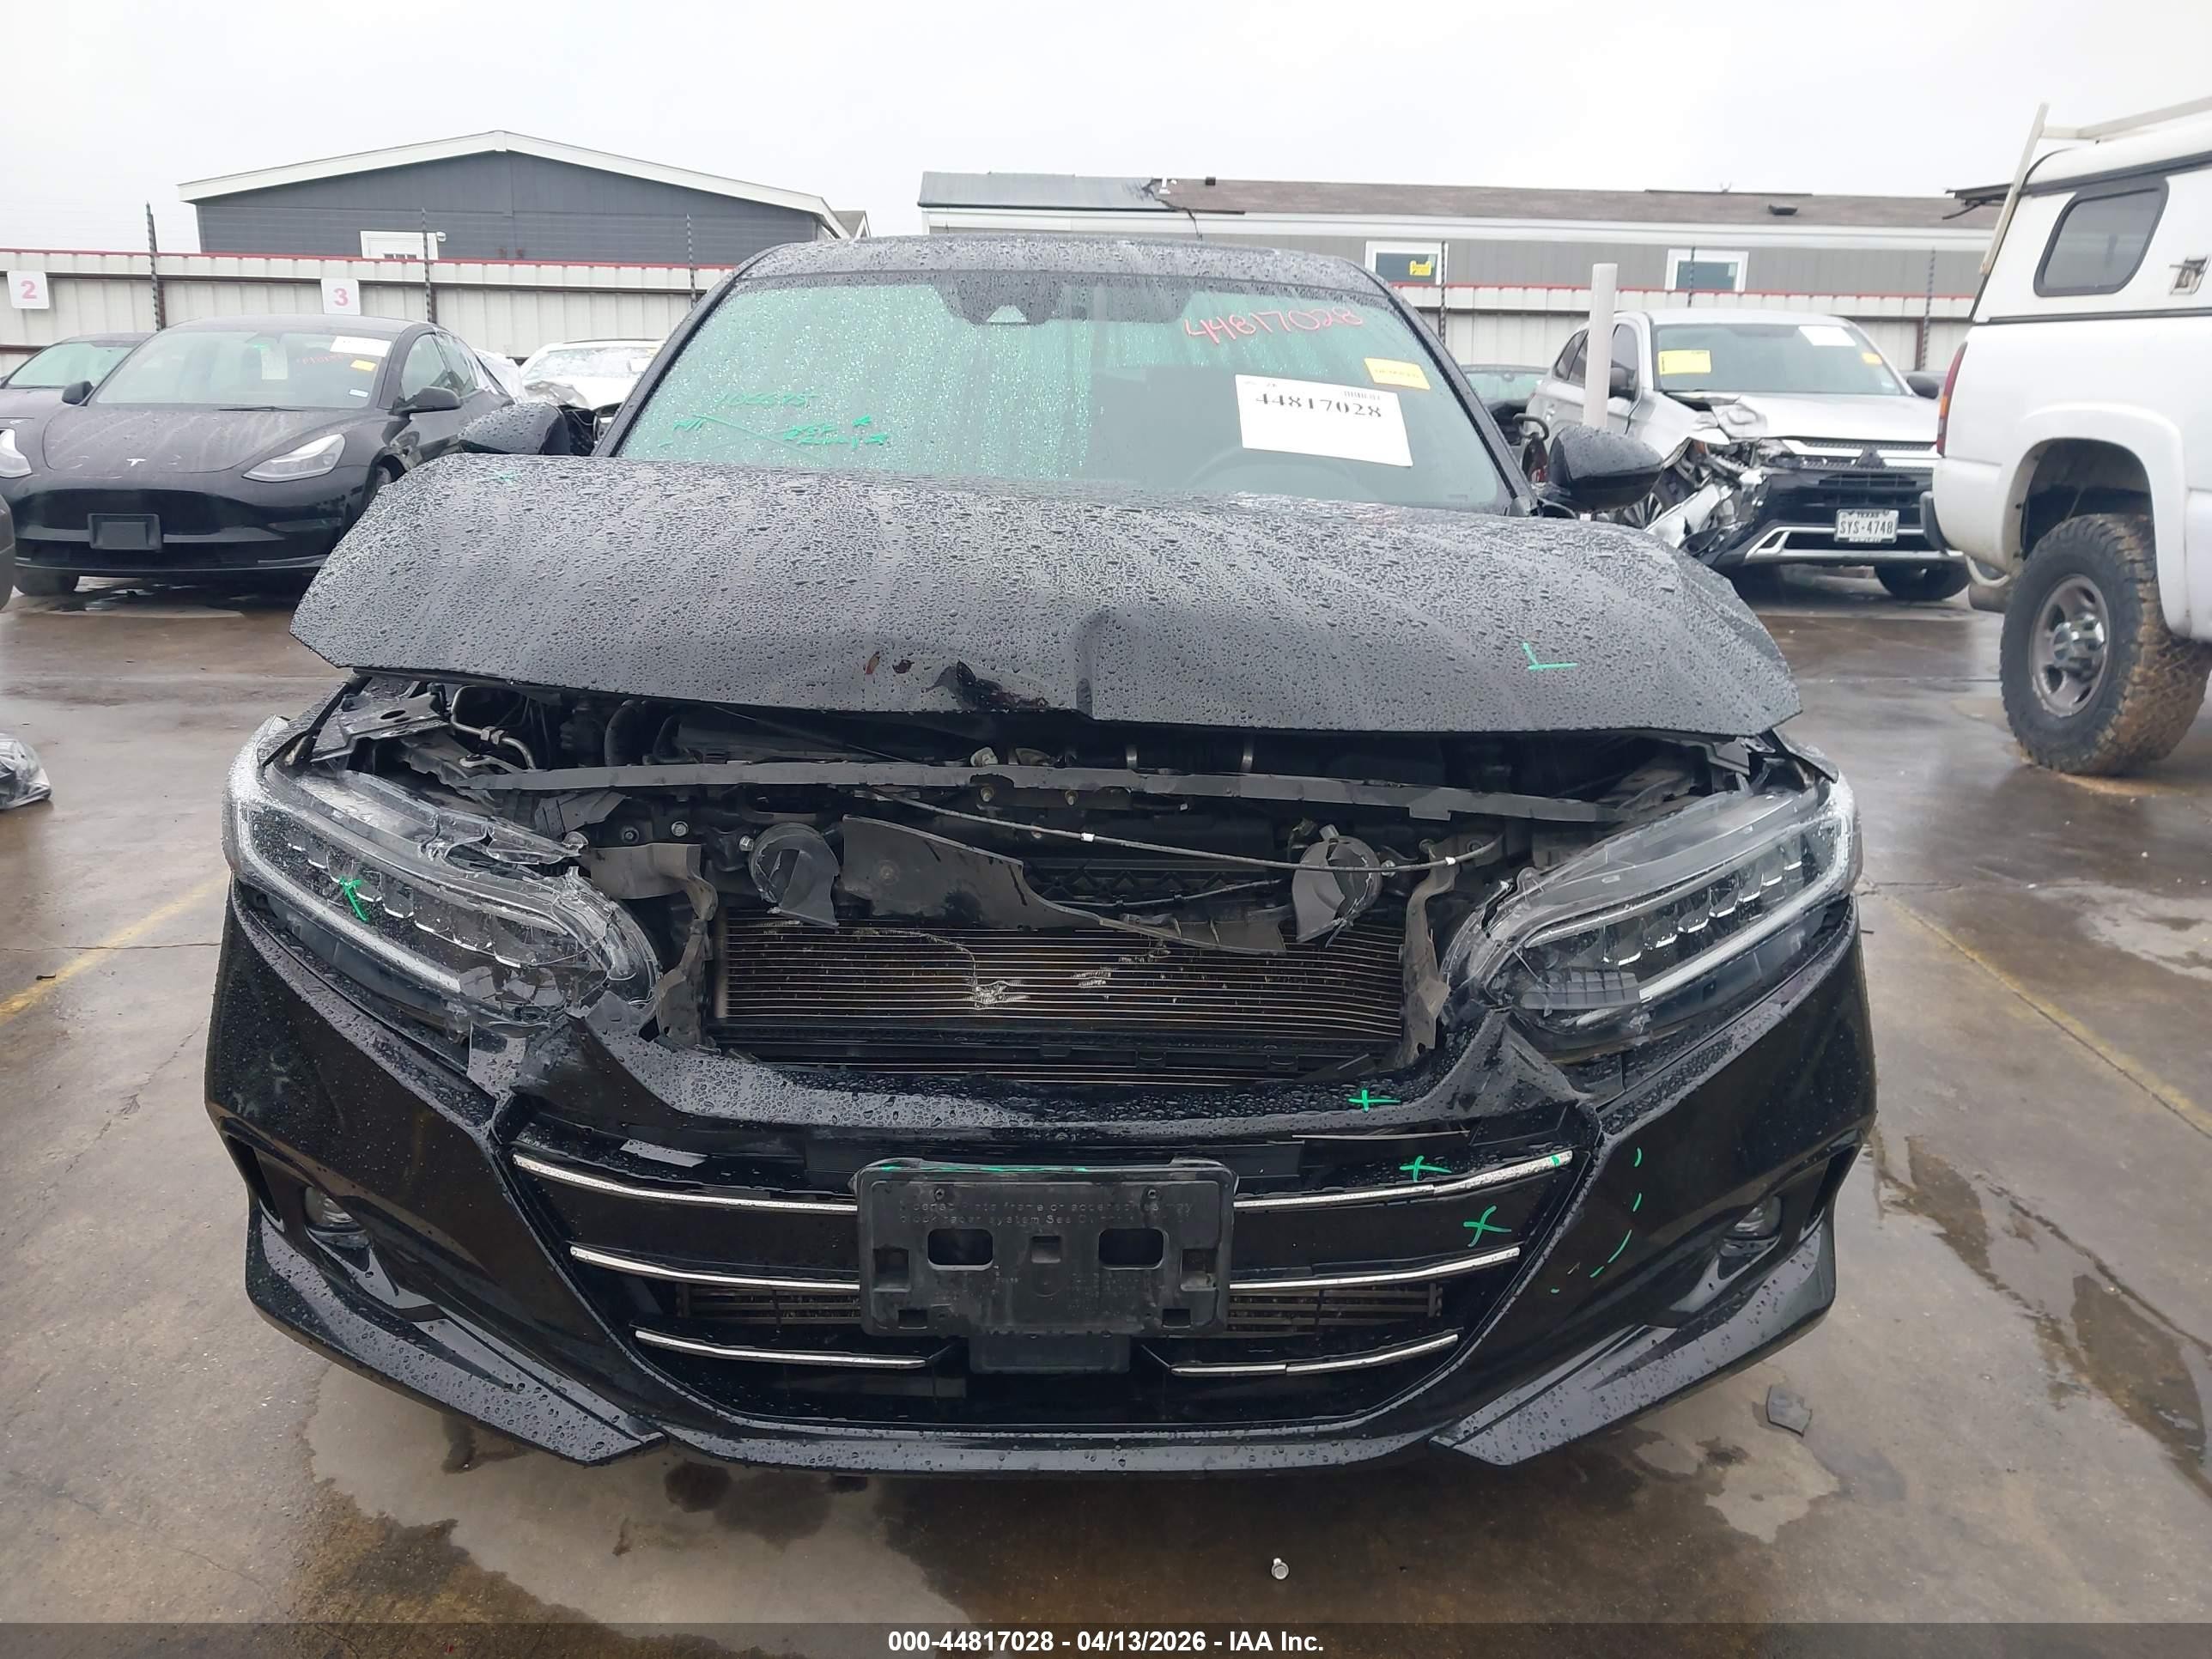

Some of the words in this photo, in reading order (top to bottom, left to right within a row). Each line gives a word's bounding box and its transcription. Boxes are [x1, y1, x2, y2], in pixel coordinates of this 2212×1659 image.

[20, 279, 37, 300] 2
[333, 288, 349, 307] 3
[1184, 307, 1364, 344] 44817028
[1256, 392, 1382, 418] 44817028
[1839, 520, 1894, 535] SYS-4748
